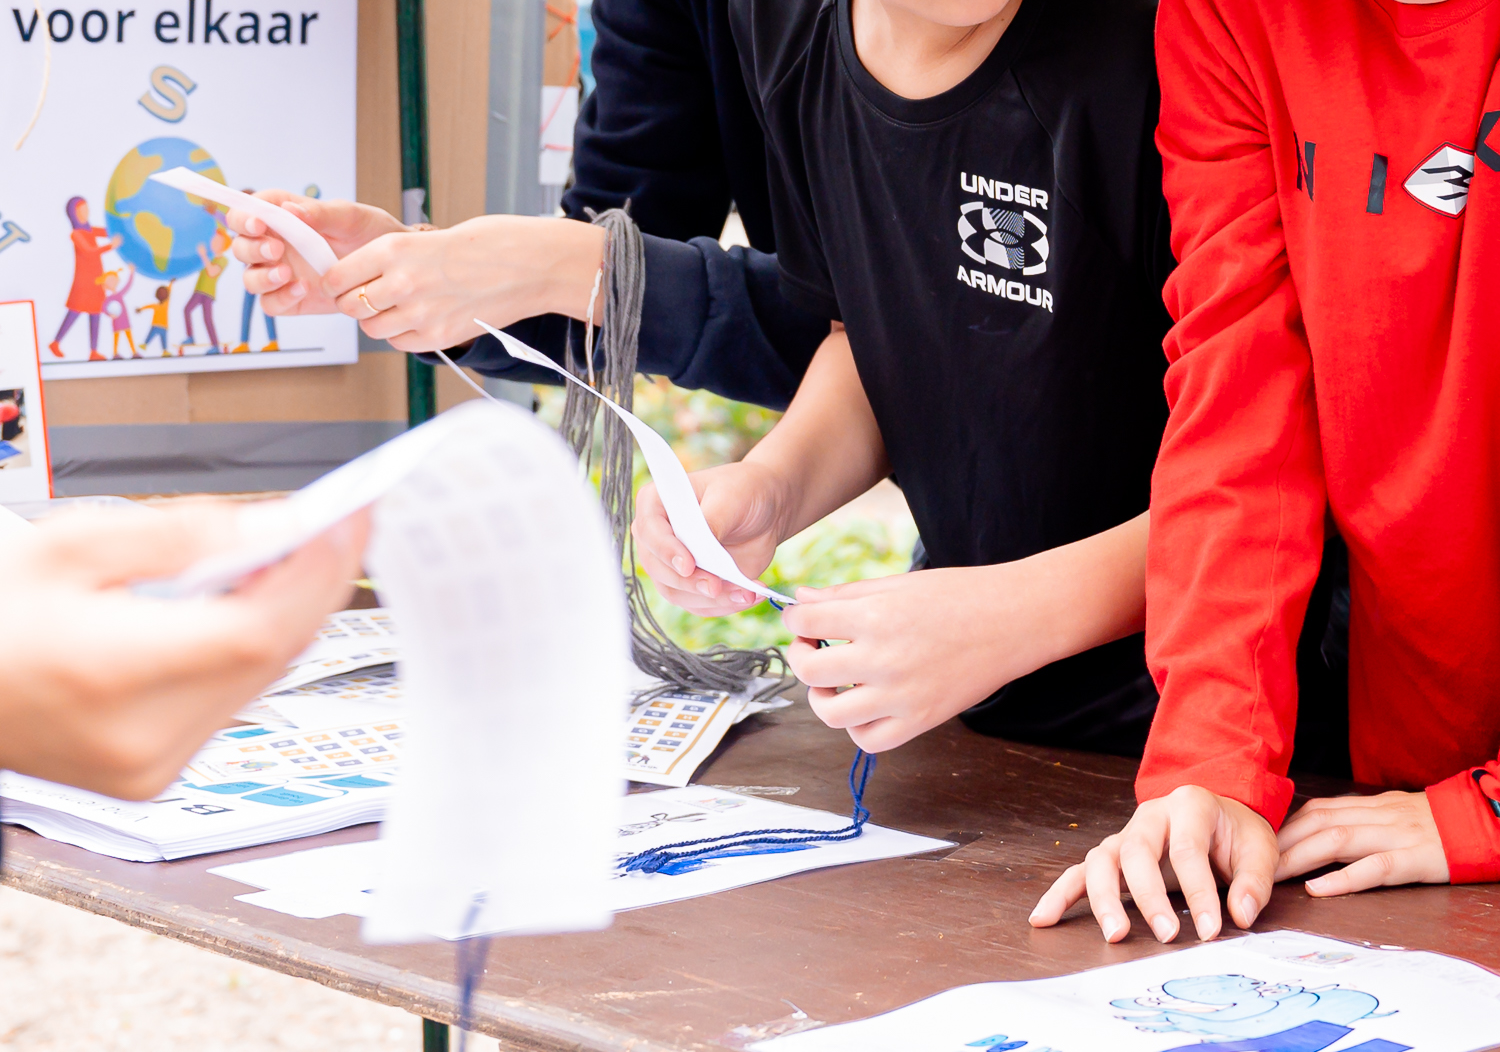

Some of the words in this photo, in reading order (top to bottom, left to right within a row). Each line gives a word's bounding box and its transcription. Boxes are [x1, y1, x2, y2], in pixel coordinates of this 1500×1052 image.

[12, 8, 136, 44] voor
[960, 171, 1049, 210] UNDER
[957, 264, 1053, 313] ARMOUR
